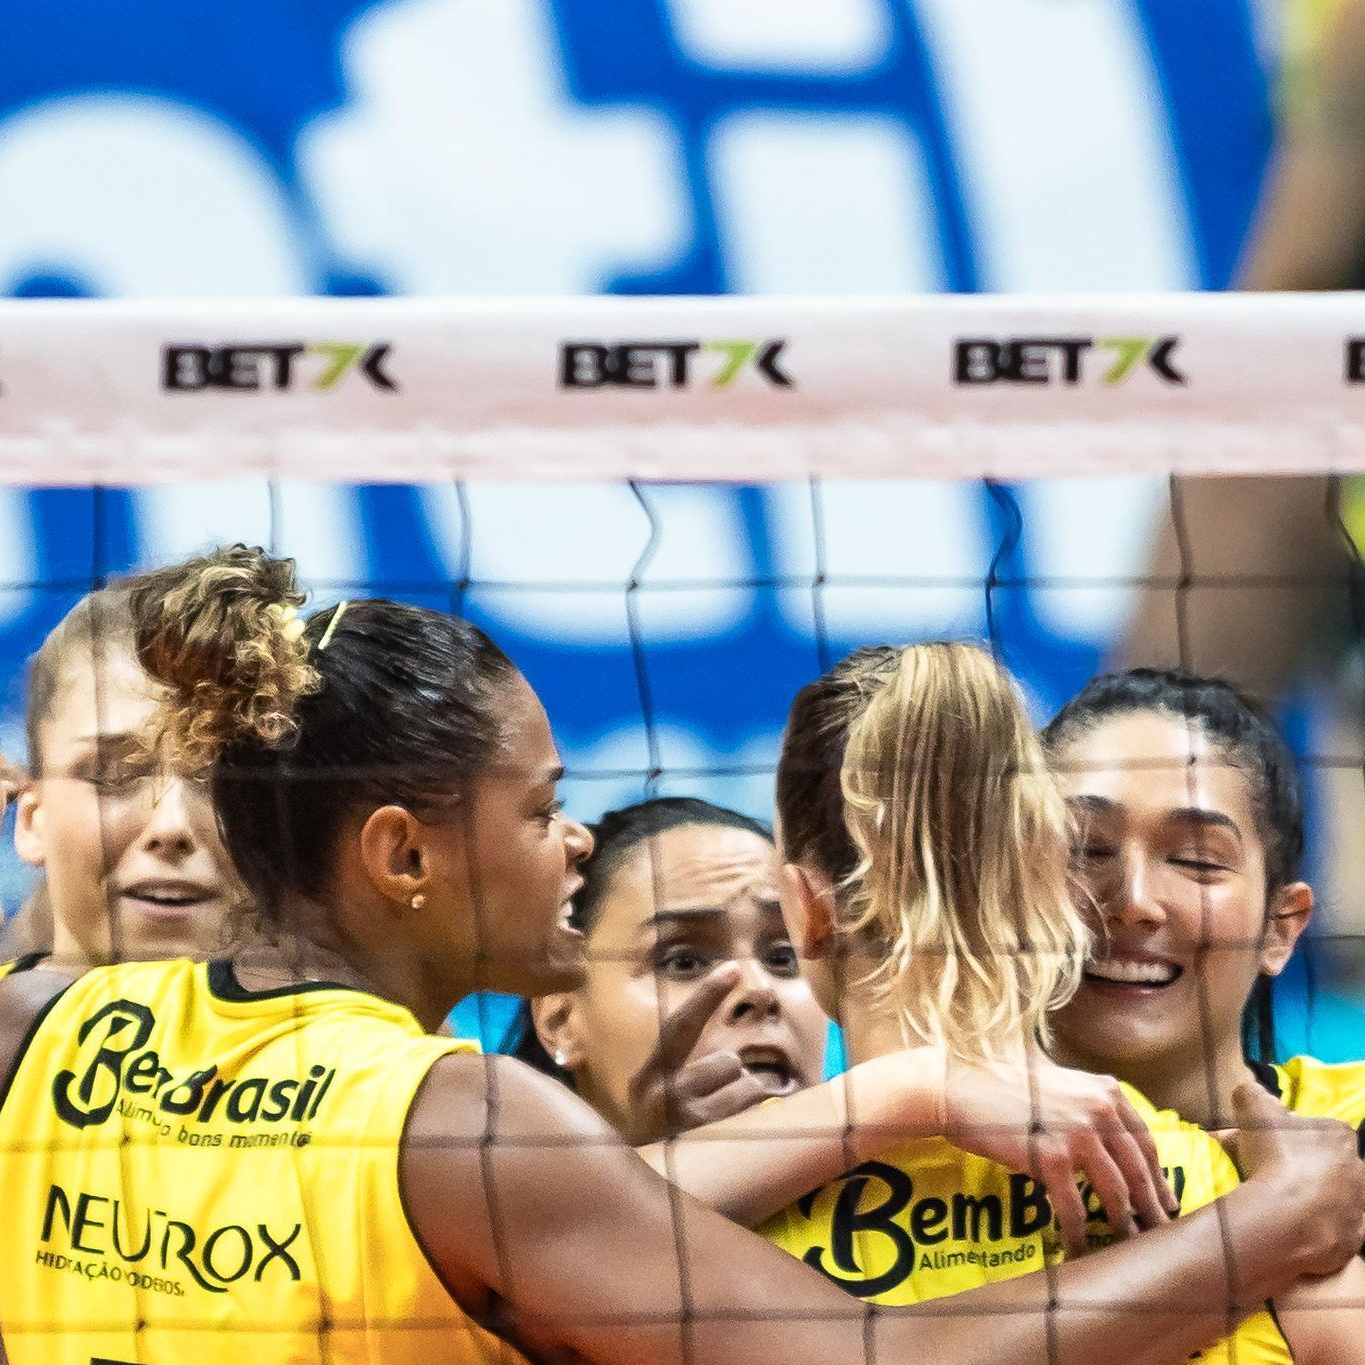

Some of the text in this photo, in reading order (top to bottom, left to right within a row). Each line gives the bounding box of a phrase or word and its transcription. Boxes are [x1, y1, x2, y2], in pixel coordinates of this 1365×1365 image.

[161, 341, 397, 393] BET7K
[559, 339, 793, 391] BET7K
[952, 335, 1184, 386] BET7K
